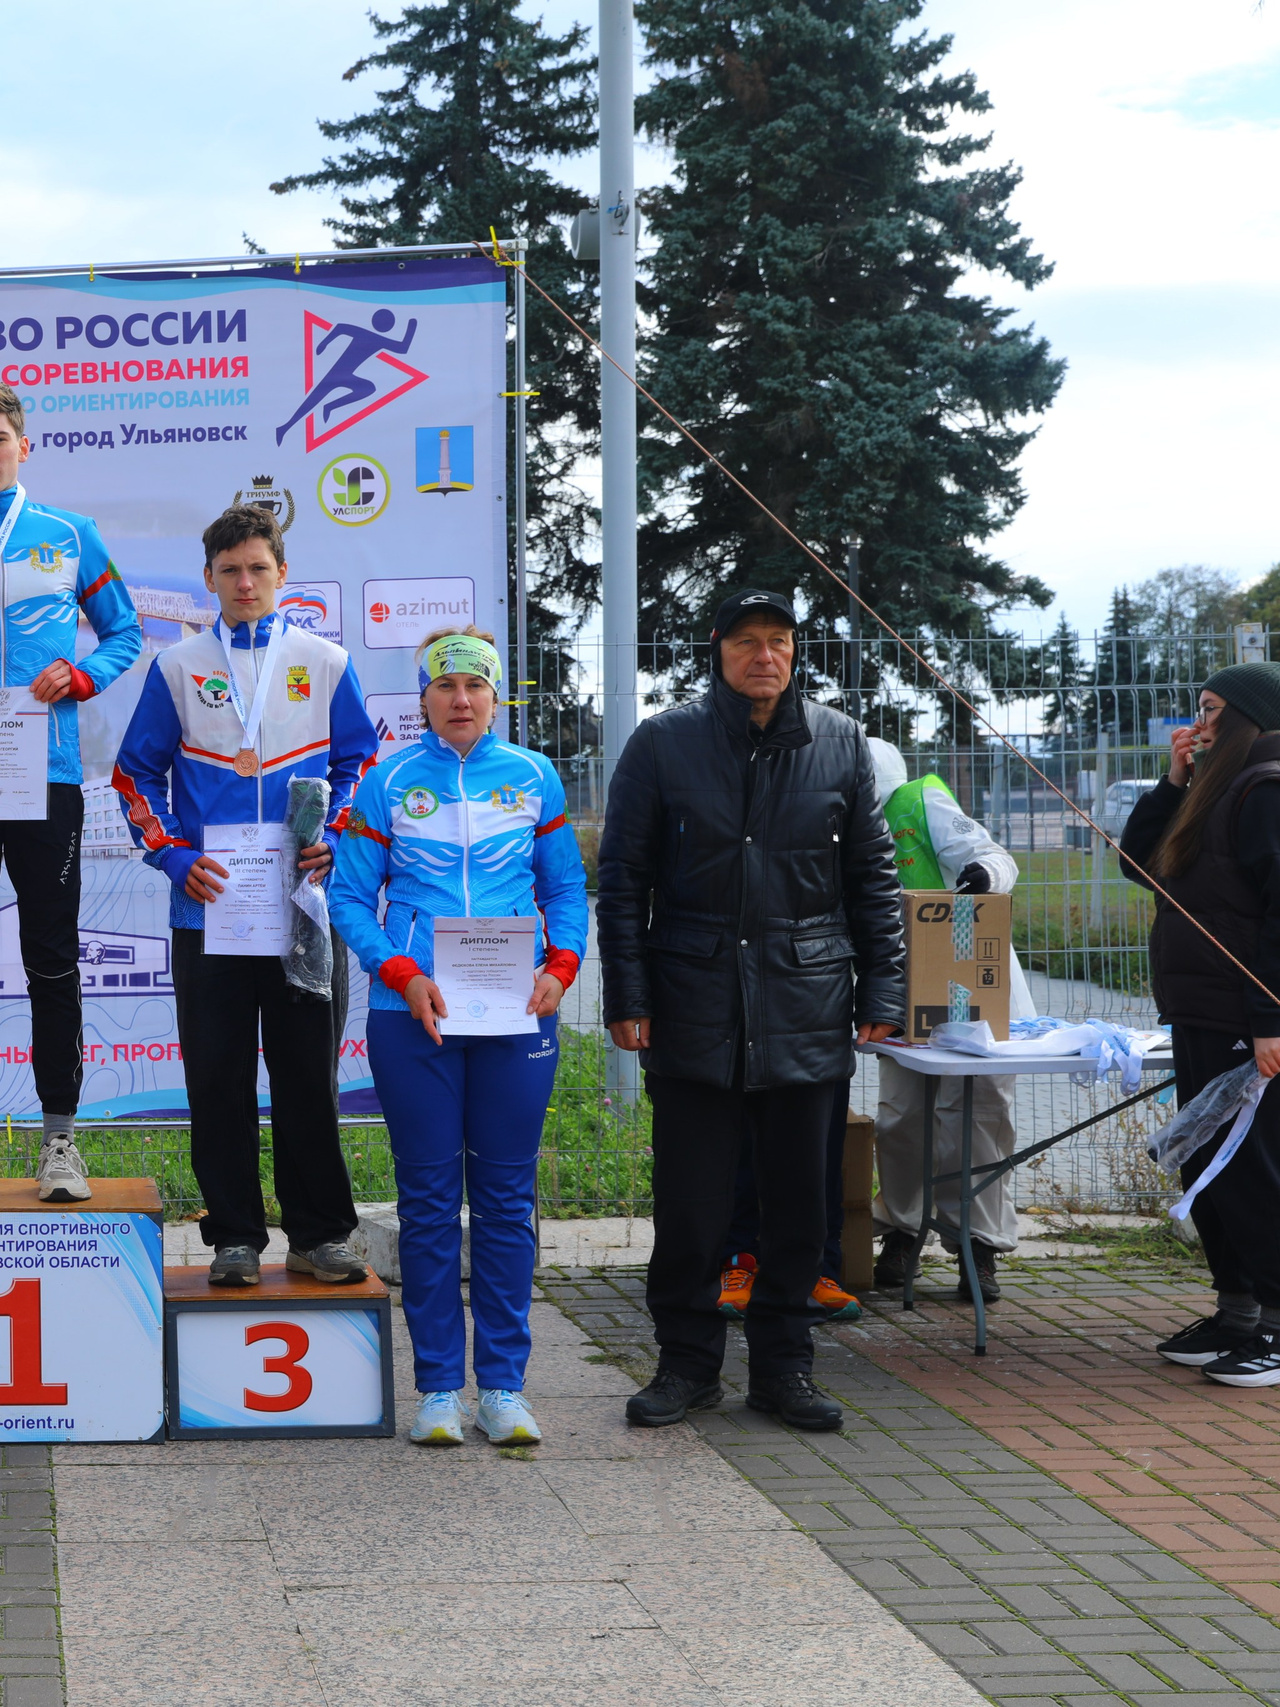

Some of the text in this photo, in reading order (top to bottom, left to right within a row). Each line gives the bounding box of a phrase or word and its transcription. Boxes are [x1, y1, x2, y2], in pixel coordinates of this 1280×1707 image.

[56, 309, 247, 349] РОССИИ
[1, 356, 249, 387] СОРЕВНОВАНИЯ
[41, 388, 250, 413] ОРИЕНТИРОВАНИЯ
[42, 429, 115, 453] город
[120, 423, 248, 445] Ульяновск
[246, 491, 281, 499] ТРИУМФ
[333, 506, 376, 516] УЛСПОРТ
[396, 598, 469, 616] azimut
[228, 857, 274, 867] ДИПЛОМ
[460, 937, 509, 945] ДИПЛОМ
[18, 1223, 131, 1236] СПОРТИВНОГО
[49, 1256, 121, 1268] ОБЛАСТИ
[242, 1320, 313, 1413] 3
